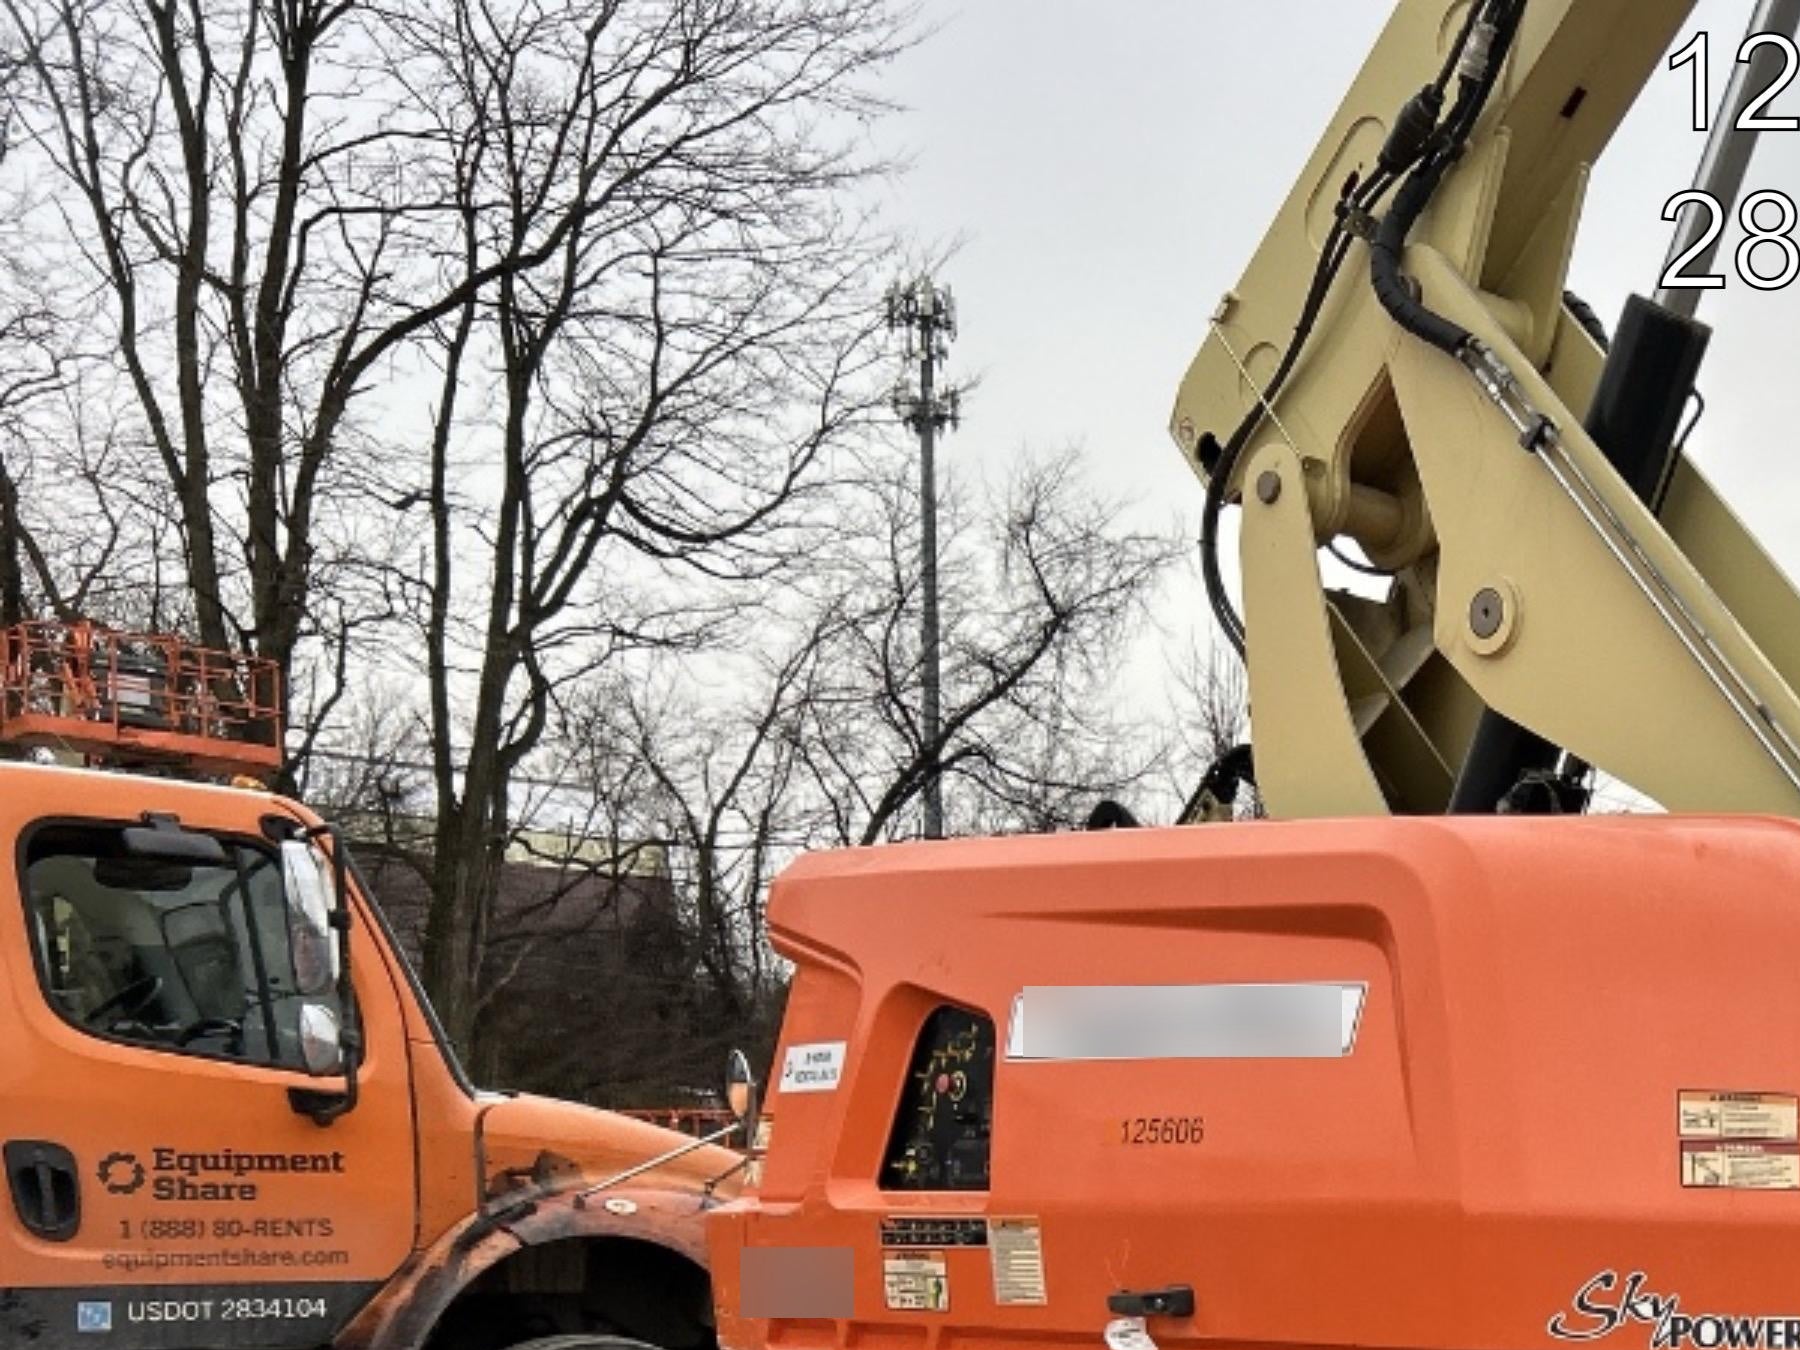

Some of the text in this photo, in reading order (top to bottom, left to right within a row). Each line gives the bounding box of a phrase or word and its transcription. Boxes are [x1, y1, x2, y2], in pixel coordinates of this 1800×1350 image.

[1120, 1117, 1205, 1145] 125606
[152, 1148, 346, 1176] Equipment
[152, 1176, 258, 1202] Share
[120, 1218, 335, 1240] 1 (888) 80-RENTS
[102, 1247, 350, 1273] equipmentshare.com
[127, 1297, 328, 1323] USDOT 2834104
